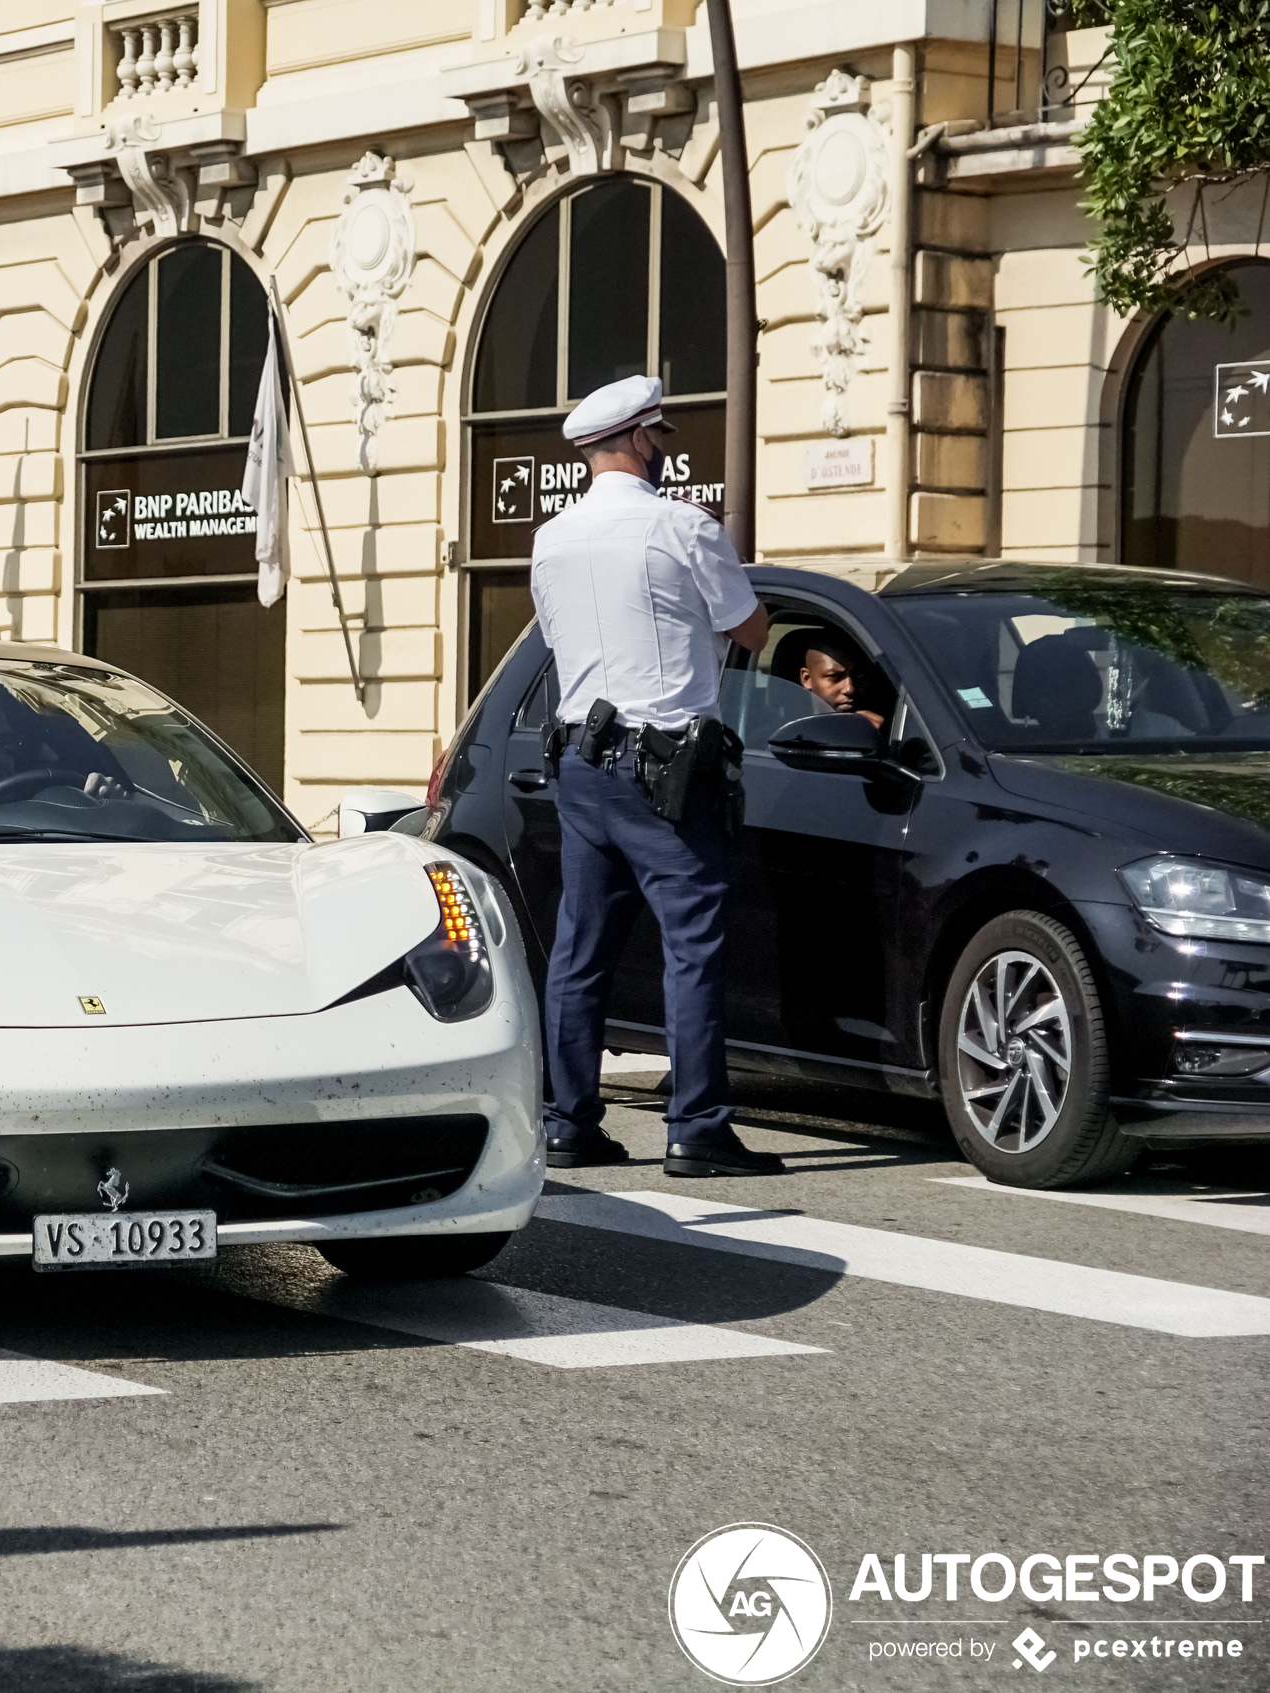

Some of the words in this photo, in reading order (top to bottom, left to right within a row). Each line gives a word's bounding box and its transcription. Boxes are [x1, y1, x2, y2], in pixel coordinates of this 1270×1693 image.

[540, 461, 587, 490] BNP
[134, 494, 173, 520] BNP
[134, 520, 187, 540] WEALTH
[46, 1222, 84, 1258] VS
[109, 1219, 205, 1256] 10933
